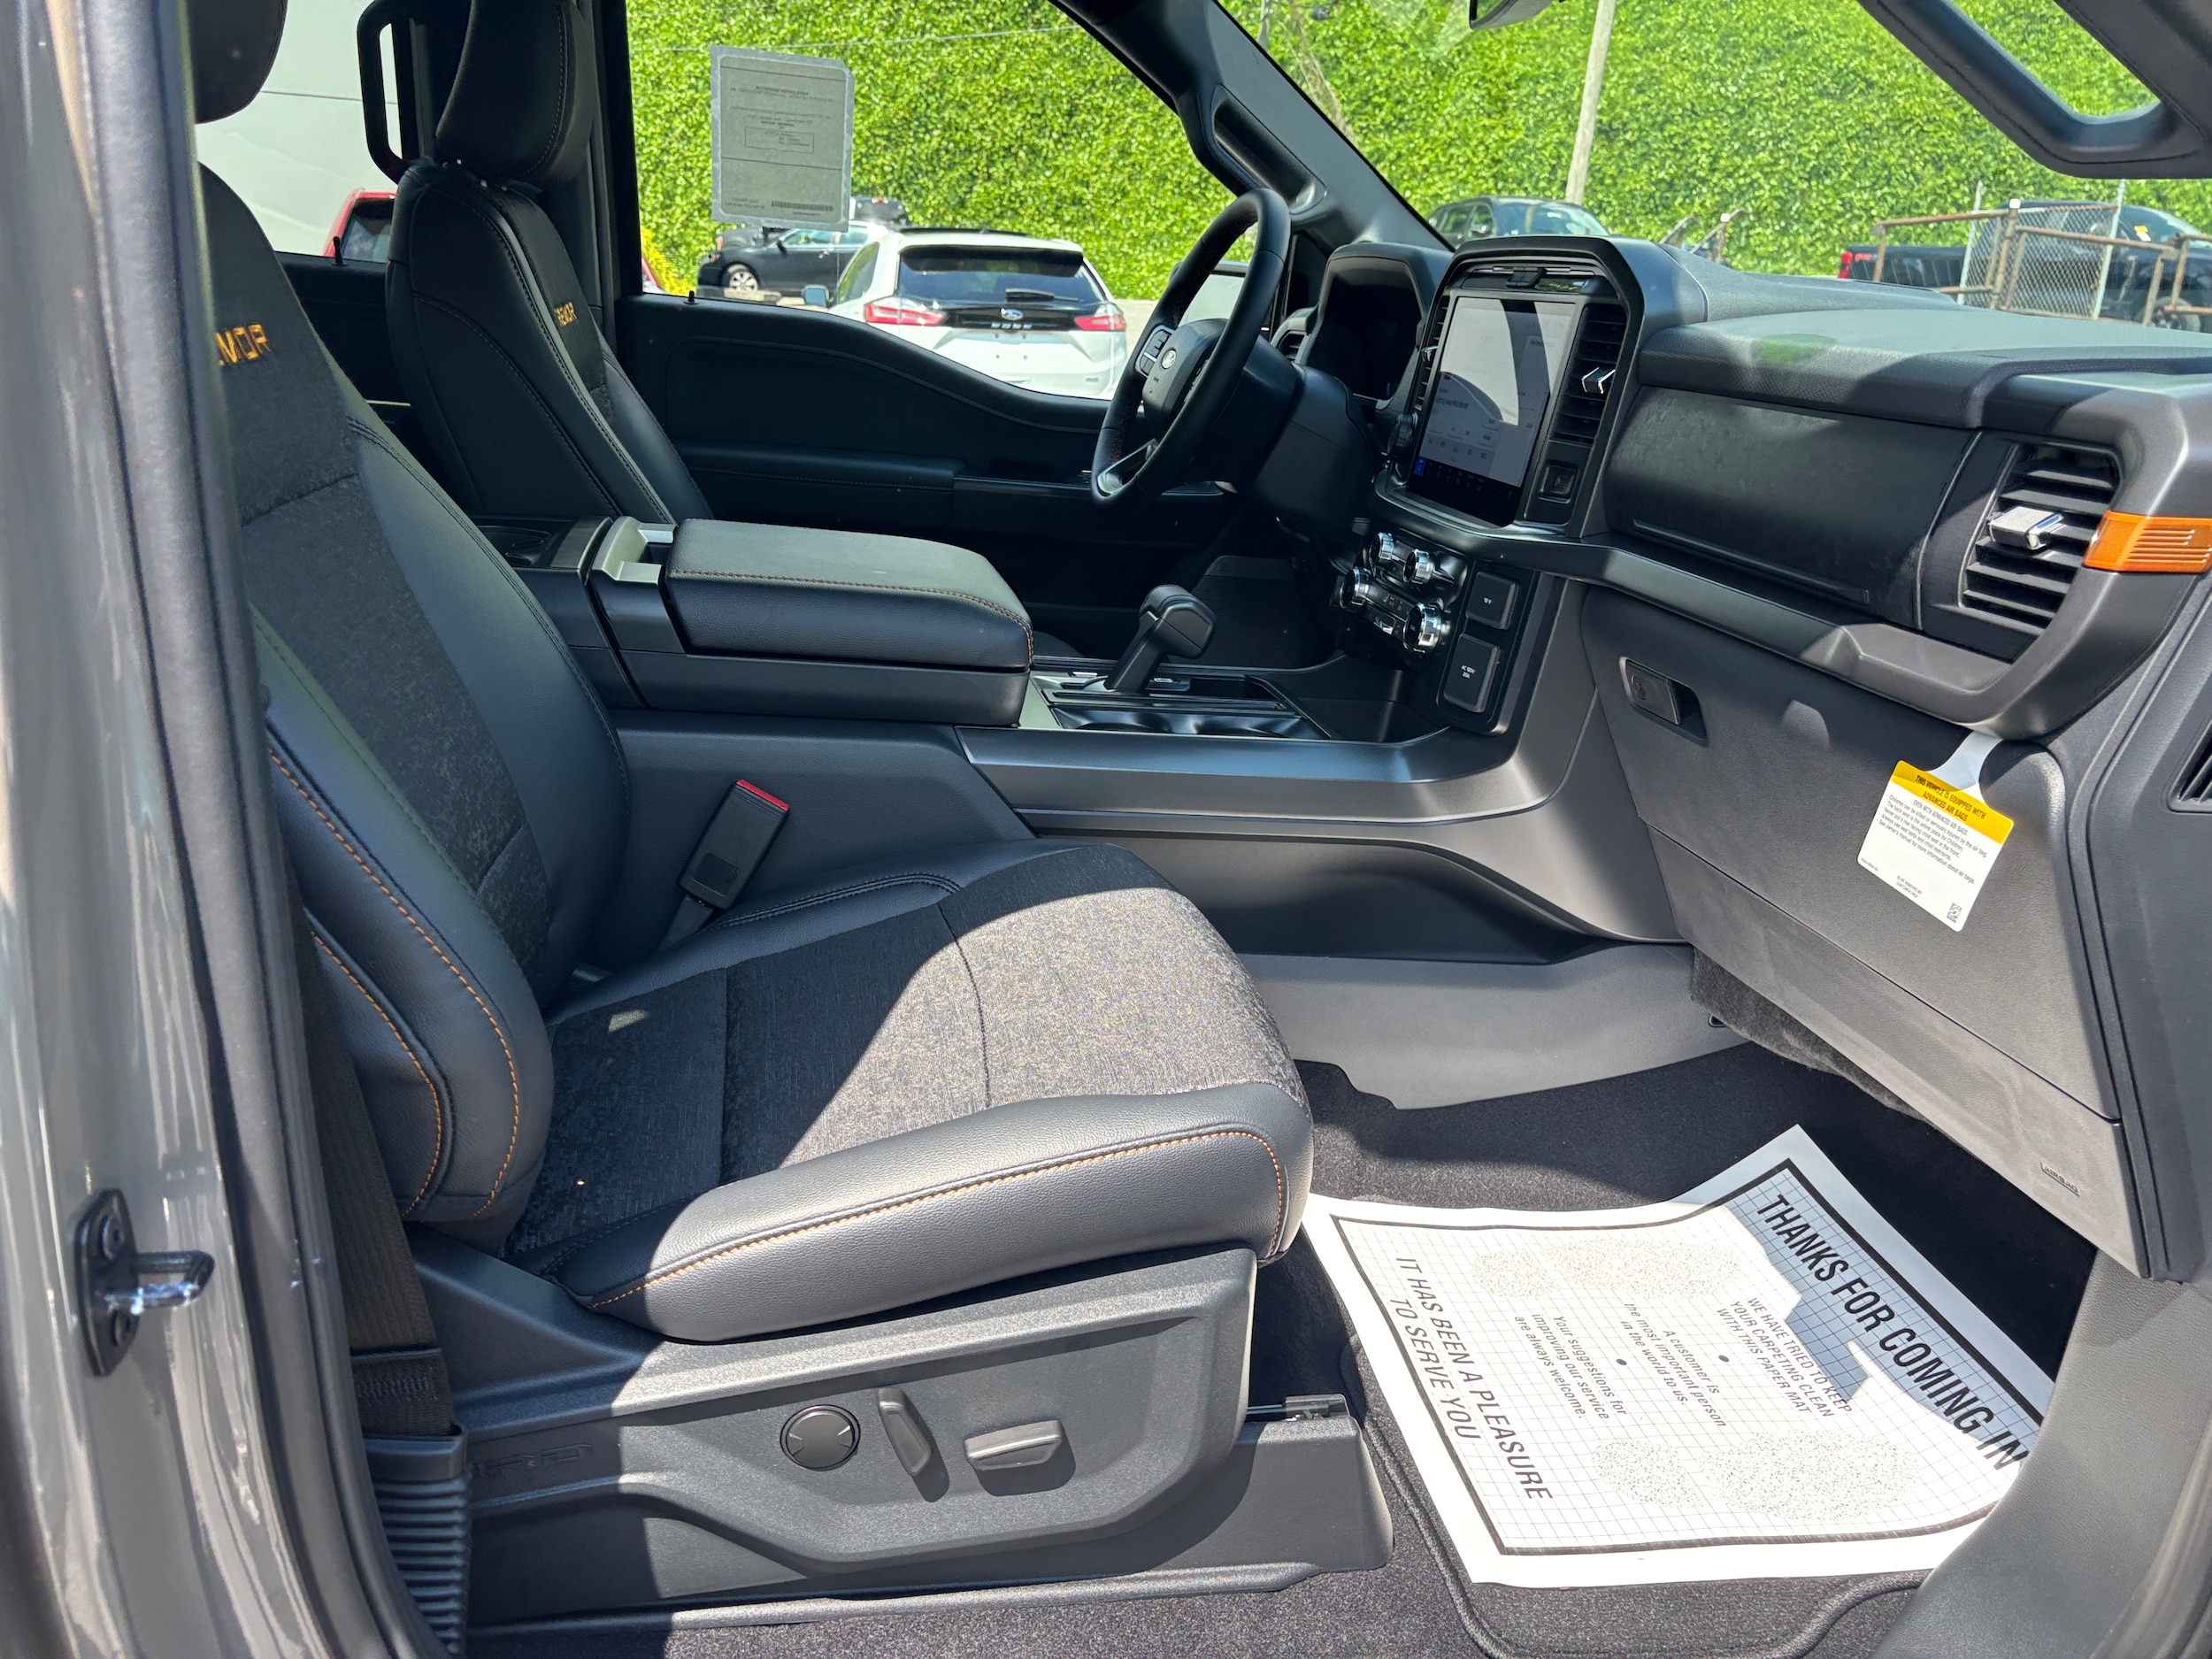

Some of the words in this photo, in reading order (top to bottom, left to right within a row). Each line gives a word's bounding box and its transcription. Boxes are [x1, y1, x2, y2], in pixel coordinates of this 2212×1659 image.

[215, 323, 273, 365] MOR
[1884, 807, 1894, 816] Never
[1910, 823, 1922, 834] facing
[1889, 795, 1903, 806] Children
[1930, 820, 1947, 833] seriously
[1946, 830, 1960, 841] injured
[1913, 799, 1923, 808] EVEN
[1923, 805, 1932, 814] WITH
[1932, 810, 1950, 825] ADVANCED
[1956, 825, 1968, 835] BAGS
[1916, 774, 1926, 785] THIS
[1925, 780, 1946, 795] VEHICLE
[1943, 790, 1949, 799] IS
[1949, 794, 1972, 811] EQUIPPED
[1971, 807, 1986, 819] WITH
[1922, 791, 1946, 809] ADVANCED
[1945, 804, 1955, 814] AIR
[1954, 809, 1968, 821] BAGS
[1881, 813, 1893, 824] Always
[1908, 830, 1916, 839] belts
[1886, 824, 1899, 835] owner's
[1898, 833, 1912, 843] manual
[1916, 844, 1926, 853] more
[1926, 850, 1947, 865] information
[1947, 864, 1959, 873] about
[1919, 822, 1931, 831] safest
[1930, 828, 1940, 837] place
[1396, 1257, 1423, 1273] IT
[1407, 1278, 1444, 1313] HAS
[1431, 1317, 1475, 1365] BEEN
[1747, 1297, 1768, 1313] WE
[1760, 1314, 1790, 1340] HAVE
[1783, 1340, 1814, 1369] TRIED
[1809, 1370, 1828, 1385] TO
[1821, 1386, 1853, 1412] KEEP
[1757, 1194, 1849, 1282] THANKS
[1830, 1277, 1896, 1333] FOR
[1878, 1327, 1995, 1434] COMING
[1976, 1430, 2030, 1471] IN
[1389, 1299, 1418, 1319] TO
[1404, 1325, 1455, 1390] SERVE
[1440, 1397, 1482, 1440] YOU
[1458, 1370, 1484, 1383] A
[1514, 1316, 1531, 1332] are
[1525, 1333, 1555, 1367] always
[1549, 1368, 1587, 1419] welcome.
[1532, 1313, 1570, 1362] improving
[1564, 1363, 1583, 1379] our
[1577, 1379, 1610, 1420] service
[1553, 1316, 1572, 1338] Your
[1570, 1338, 1615, 1398] suggestions
[1609, 1399, 1628, 1416] for
[1620, 1320, 1633, 1329] in
[1629, 1332, 1646, 1348] the
[1642, 1348, 1670, 1376] world
[1663, 1377, 1677, 1388] to
[1672, 1390, 1689, 1406] us.
[1624, 1303, 1641, 1317] the
[1637, 1318, 1662, 1341] most
[1655, 1343, 1699, 1390] important
[1688, 1391, 1726, 1426] person
[1662, 1329, 1677, 1338] A
[1672, 1338, 1713, 1383] customer
[1705, 1384, 1720, 1394] is
[1717, 1308, 1744, 1332] WITH
[1738, 1333, 1763, 1355] THIS
[1756, 1356, 1791, 1390] PAPER
[1785, 1390, 1813, 1413] MAT
[1730, 1301, 1757, 1328] YOUR
[1752, 1327, 1804, 1382] CARPETING
[1798, 1384, 1835, 1417] CLEAN
[1469, 1389, 1554, 1500] PLEASURE
